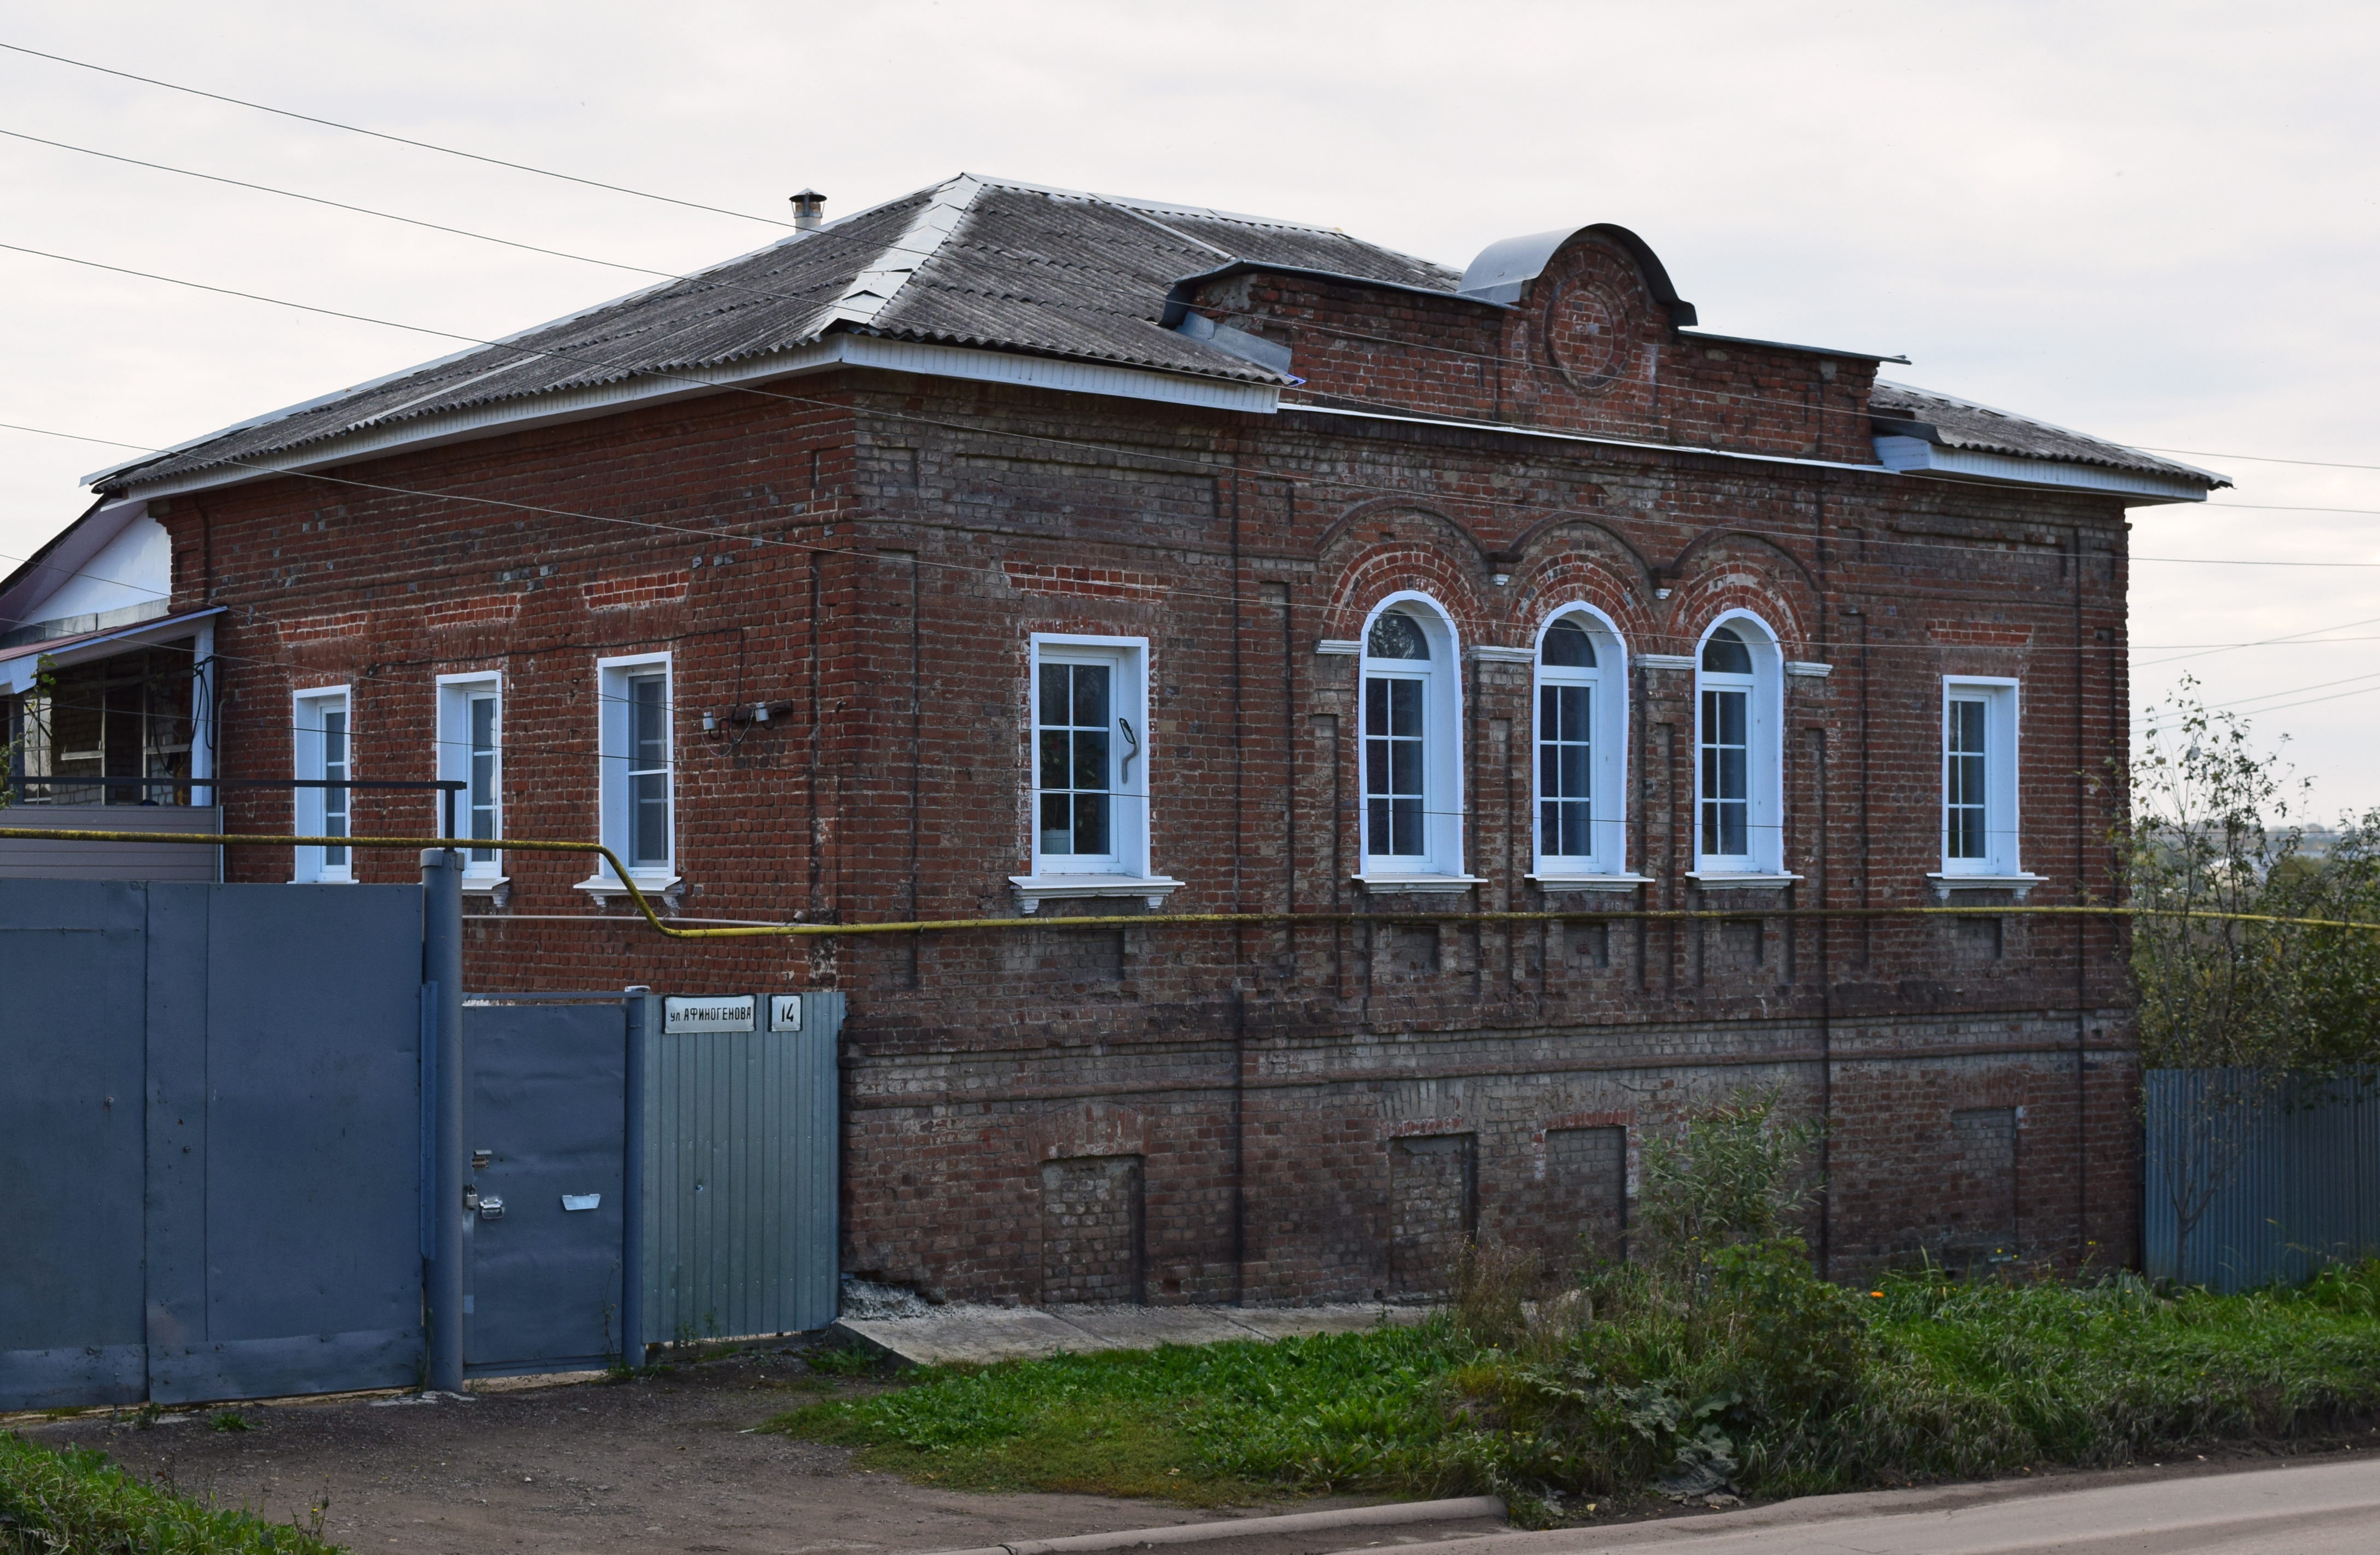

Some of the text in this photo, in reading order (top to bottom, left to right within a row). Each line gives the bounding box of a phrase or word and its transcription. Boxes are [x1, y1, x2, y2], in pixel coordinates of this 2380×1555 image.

[670, 1007, 751, 1021] ул АФИНОГЕНОВА
[781, 1003, 794, 1022] 14
